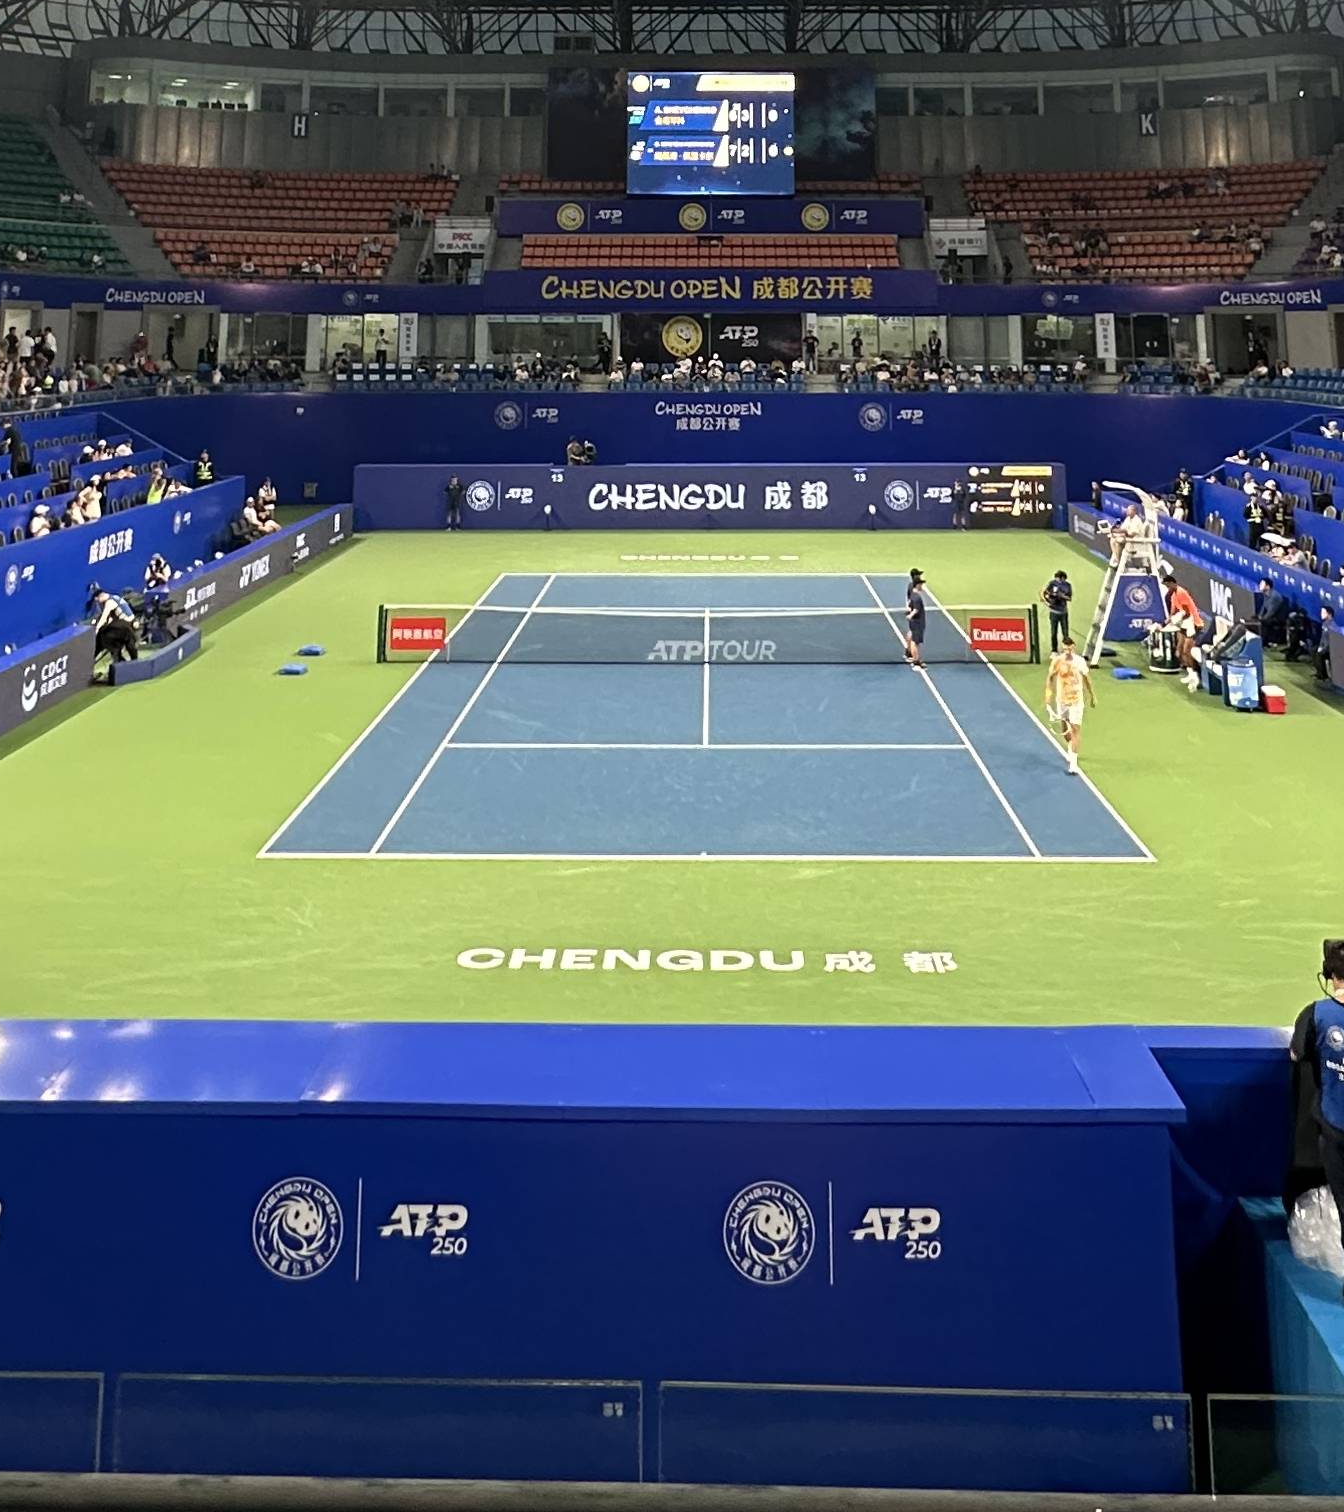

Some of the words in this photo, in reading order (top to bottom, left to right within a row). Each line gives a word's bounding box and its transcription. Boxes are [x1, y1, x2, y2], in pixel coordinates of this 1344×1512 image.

[294, 115, 306, 137] H
[1141, 113, 1154, 135] K
[741, 144, 750, 157] 2
[594, 208, 623, 220] ATP
[717, 208, 745, 220] ATP
[840, 209, 868, 220] ATP
[106, 287, 167, 304] CHENGDU
[168, 289, 205, 305] OPEN
[541, 275, 665, 300] CHENGDU
[668, 276, 741, 300] OPEN
[752, 275, 874, 301] 成都公开赛
[1220, 291, 1285, 305] CHENGDU
[1286, 289, 1322, 304] OPEN
[719, 325, 759, 340] ATP
[532, 407, 559, 419] ATP
[655, 401, 723, 416] CHENGDU
[723, 402, 762, 416] OPEN
[896, 408, 924, 420] ATP
[676, 417, 741, 431] 成都公开赛
[551, 473, 564, 483] 13
[854, 473, 867, 482] 13
[505, 488, 533, 499] ATP
[588, 482, 746, 511] CHENGDU
[764, 480, 829, 510] 成都
[88, 528, 134, 565] 成都公开赛
[973, 628, 1024, 642] Emirates
[648, 640, 704, 661] ATP
[706, 640, 776, 661] TOUR
[40, 654, 69, 681] CDCT
[456, 947, 805, 974] CHENGDU
[823, 949, 959, 975] 成都
[259, 1182, 312, 1225] CHENGDU
[313, 1188, 339, 1226] OPEN
[728, 1186, 782, 1229] CHENGDU
[782, 1191, 810, 1230] OPEN
[377, 1204, 469, 1237] ATP
[849, 1207, 942, 1241] ATP
[430, 1237, 469, 1256] 250
[904, 1240, 942, 1260] 250
